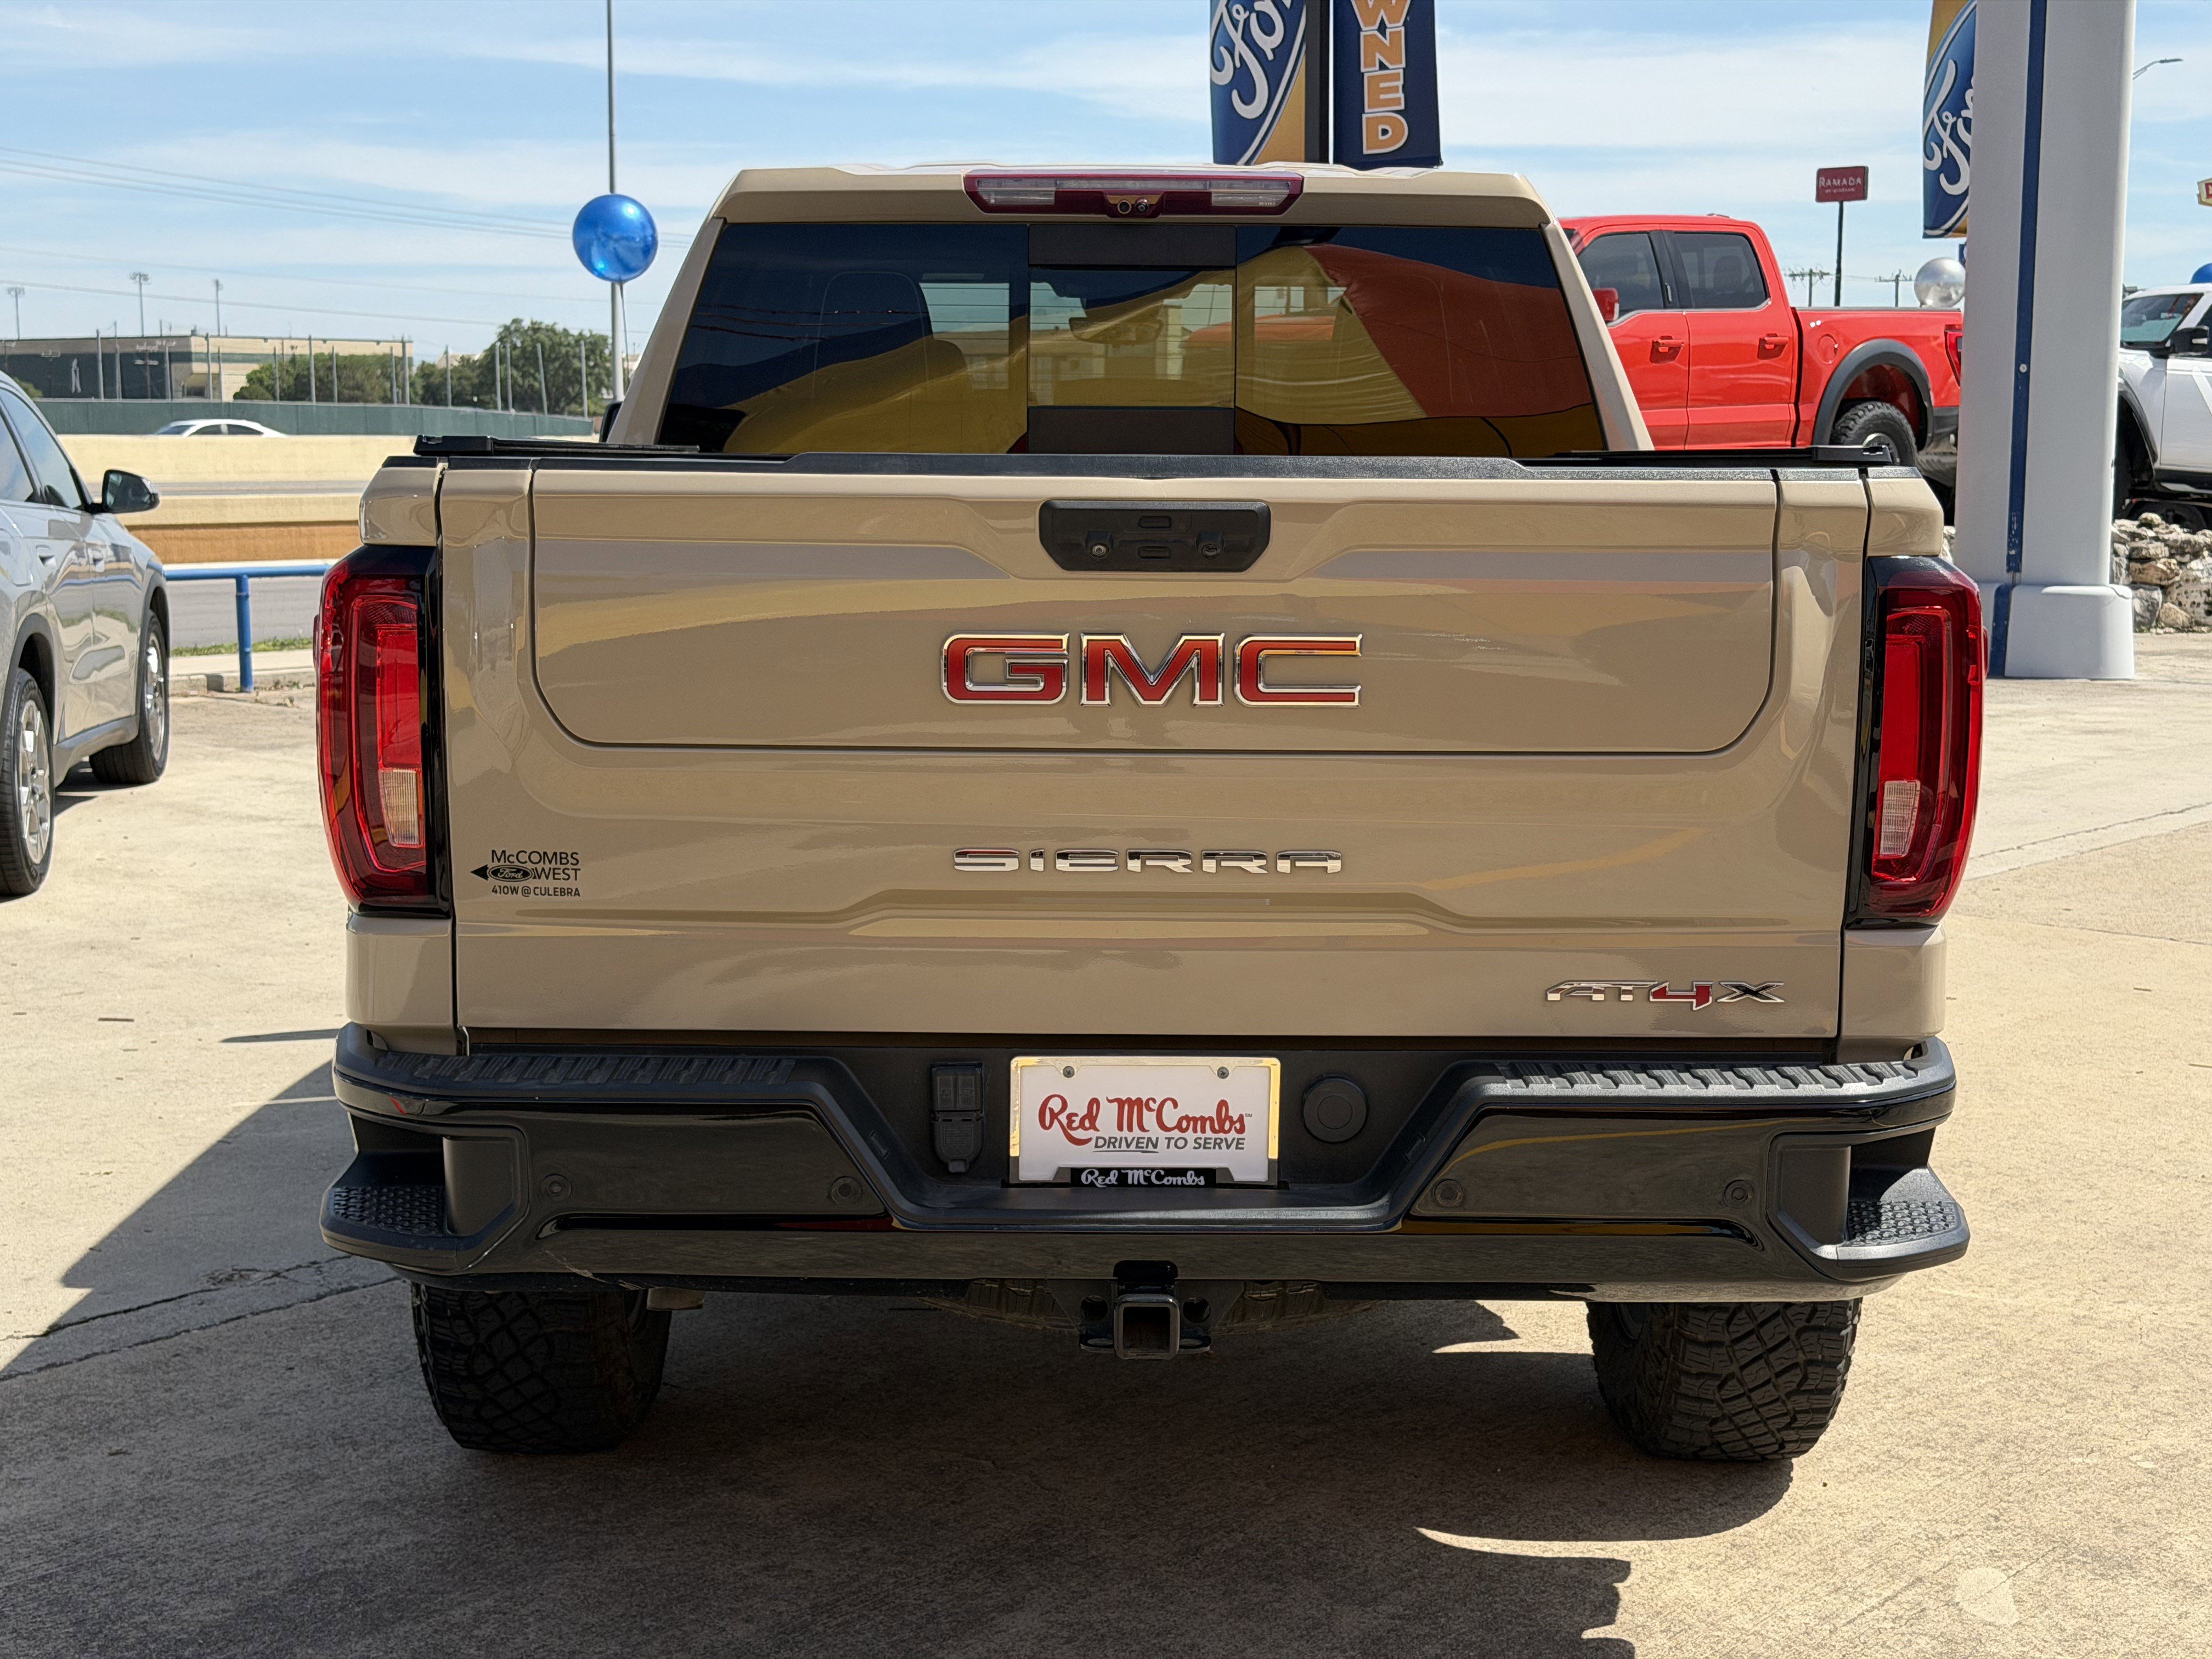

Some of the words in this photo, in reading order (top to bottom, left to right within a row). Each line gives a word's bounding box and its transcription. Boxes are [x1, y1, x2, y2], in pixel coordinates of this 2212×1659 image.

[1819, 176, 1861, 188] RAMADA
[940, 633, 1363, 707] GMC
[491, 849, 580, 866] McCOMBS
[953, 848, 1342, 874] SIERRA
[497, 868, 523, 879] Ford
[533, 867, 581, 881] WEST
[1546, 980, 1785, 1011] AT4X
[1038, 1093, 1101, 1146] Red
[1106, 1096, 1246, 1135] McCombs
[1094, 1136, 1159, 1149] DRIVEN
[1165, 1136, 1188, 1150] TO
[1193, 1137, 1246, 1150] SERVE
[1081, 1169, 1118, 1188] Red
[1121, 1169, 1205, 1186] McCombs
